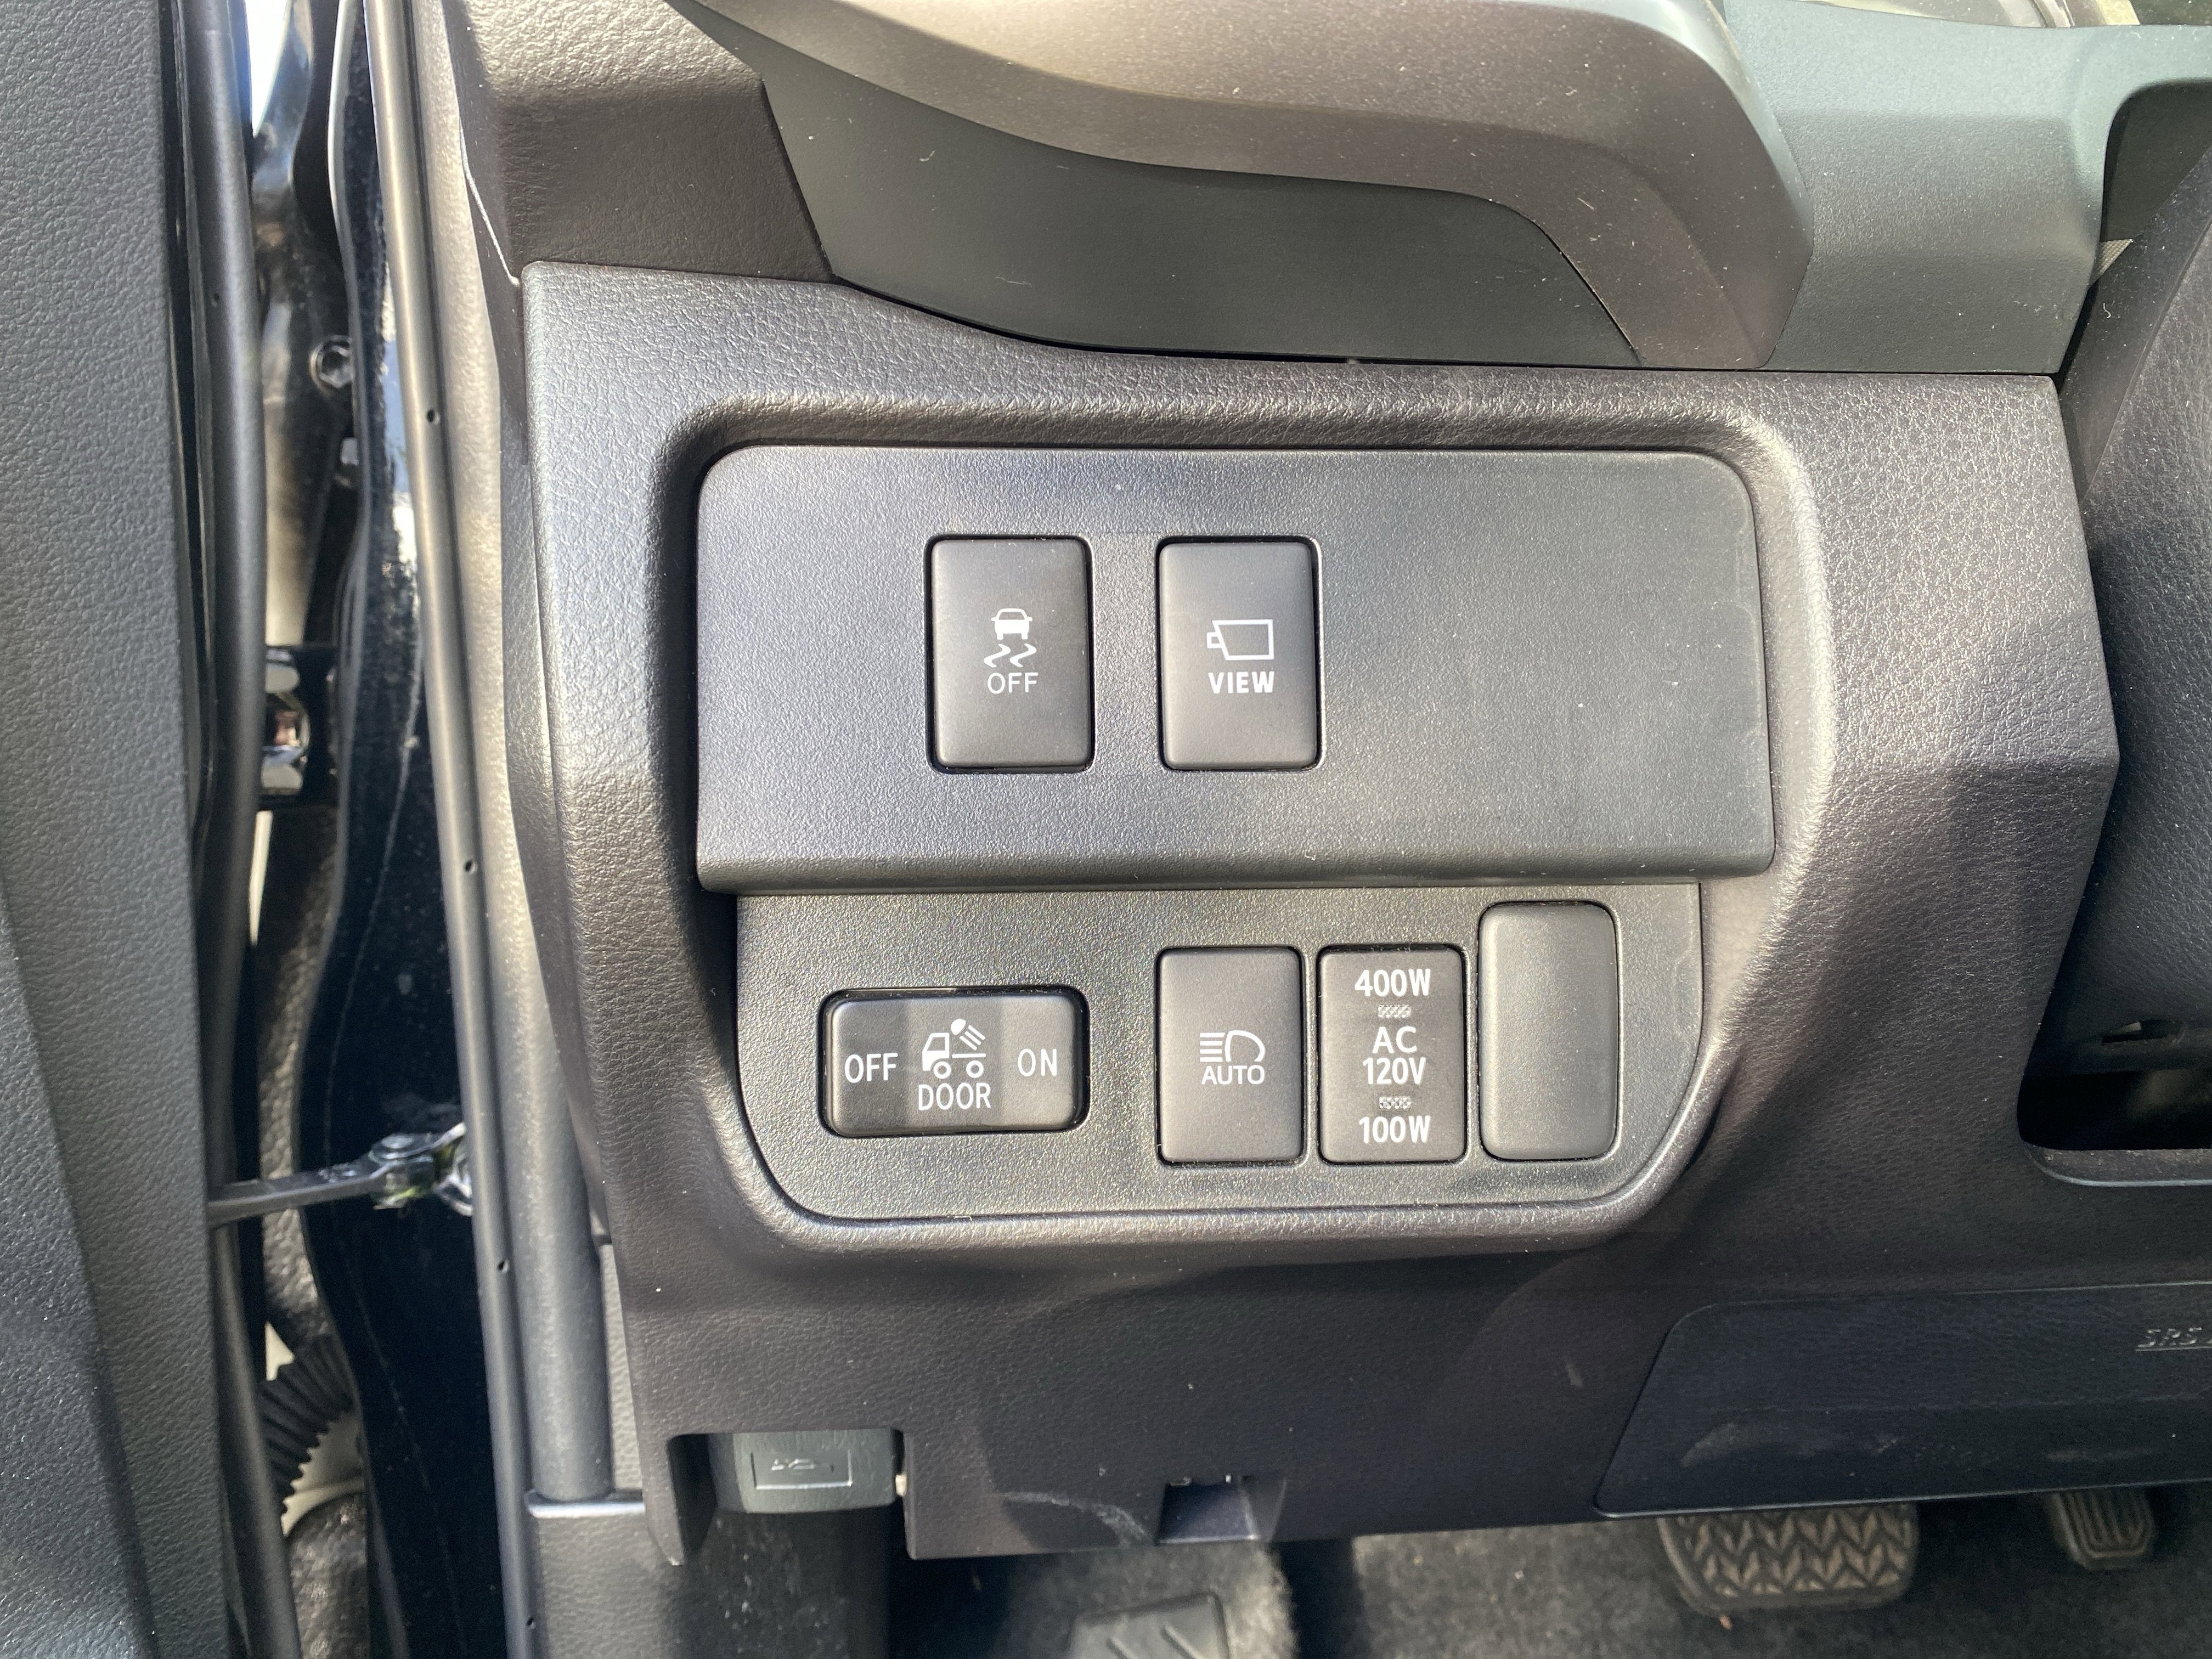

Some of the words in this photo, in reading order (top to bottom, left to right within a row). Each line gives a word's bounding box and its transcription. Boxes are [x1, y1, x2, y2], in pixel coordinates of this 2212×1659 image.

[987, 672, 1039, 694] OFF
[1208, 671, 1275, 693] VIEW
[1355, 968, 1431, 997] 400W
[1372, 1026, 1417, 1053] AC
[844, 1053, 899, 1083] OFF
[1018, 1048, 1058, 1076] ON
[1201, 1065, 1266, 1085] AUTO
[1363, 1057, 1426, 1085] 120V
[918, 1082, 991, 1110] DOOR
[1359, 1116, 1431, 1144] 100W
